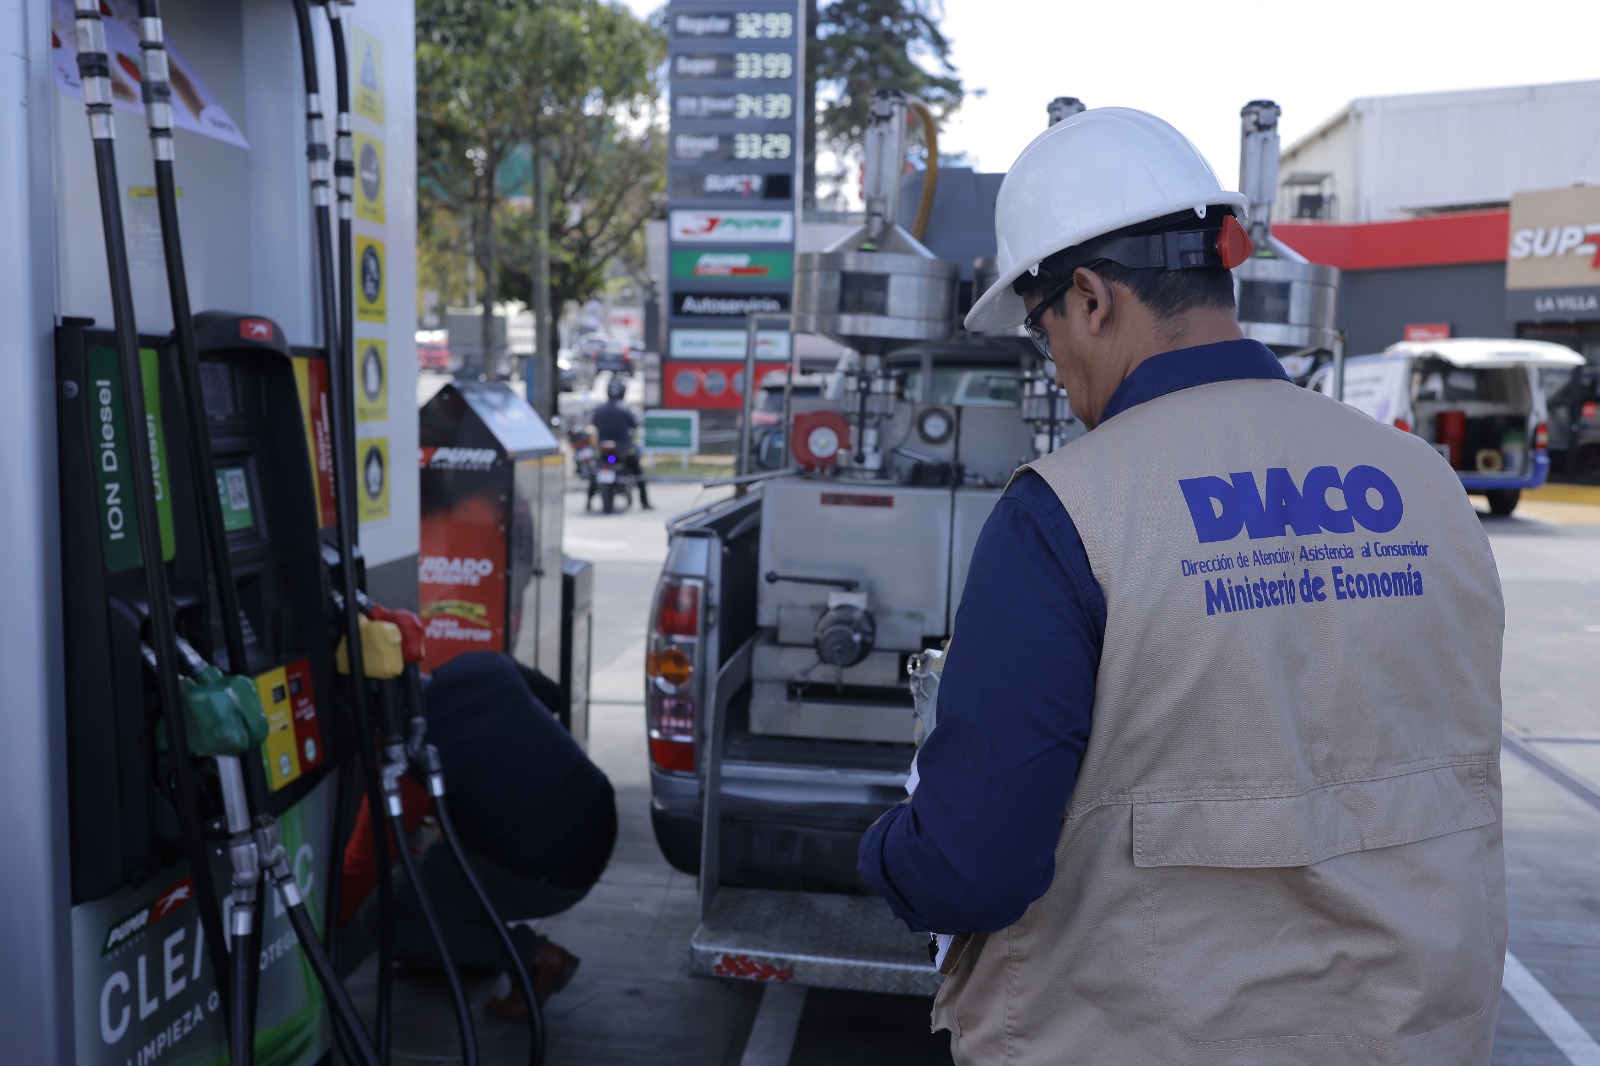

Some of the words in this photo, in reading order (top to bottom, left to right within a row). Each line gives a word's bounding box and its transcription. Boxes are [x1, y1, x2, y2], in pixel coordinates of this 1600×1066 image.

[681, 296, 781, 316] Autoservicio
[1534, 295, 1555, 312] LA
[1556, 294, 1599, 311] VILLA
[96, 379, 118, 473] Diesel
[105, 482, 125, 540] ION
[1178, 464, 1404, 544] DIACO
[1181, 553, 1235, 577] Dirección
[1236, 551, 1249, 568] de
[1299, 544, 1354, 562] Asistencia
[1361, 541, 1371, 558] al
[1373, 541, 1429, 558] Consumidor
[1204, 571, 1296, 616] Ministerio
[1299, 568, 1328, 603] de
[1331, 563, 1424, 601] Economía
